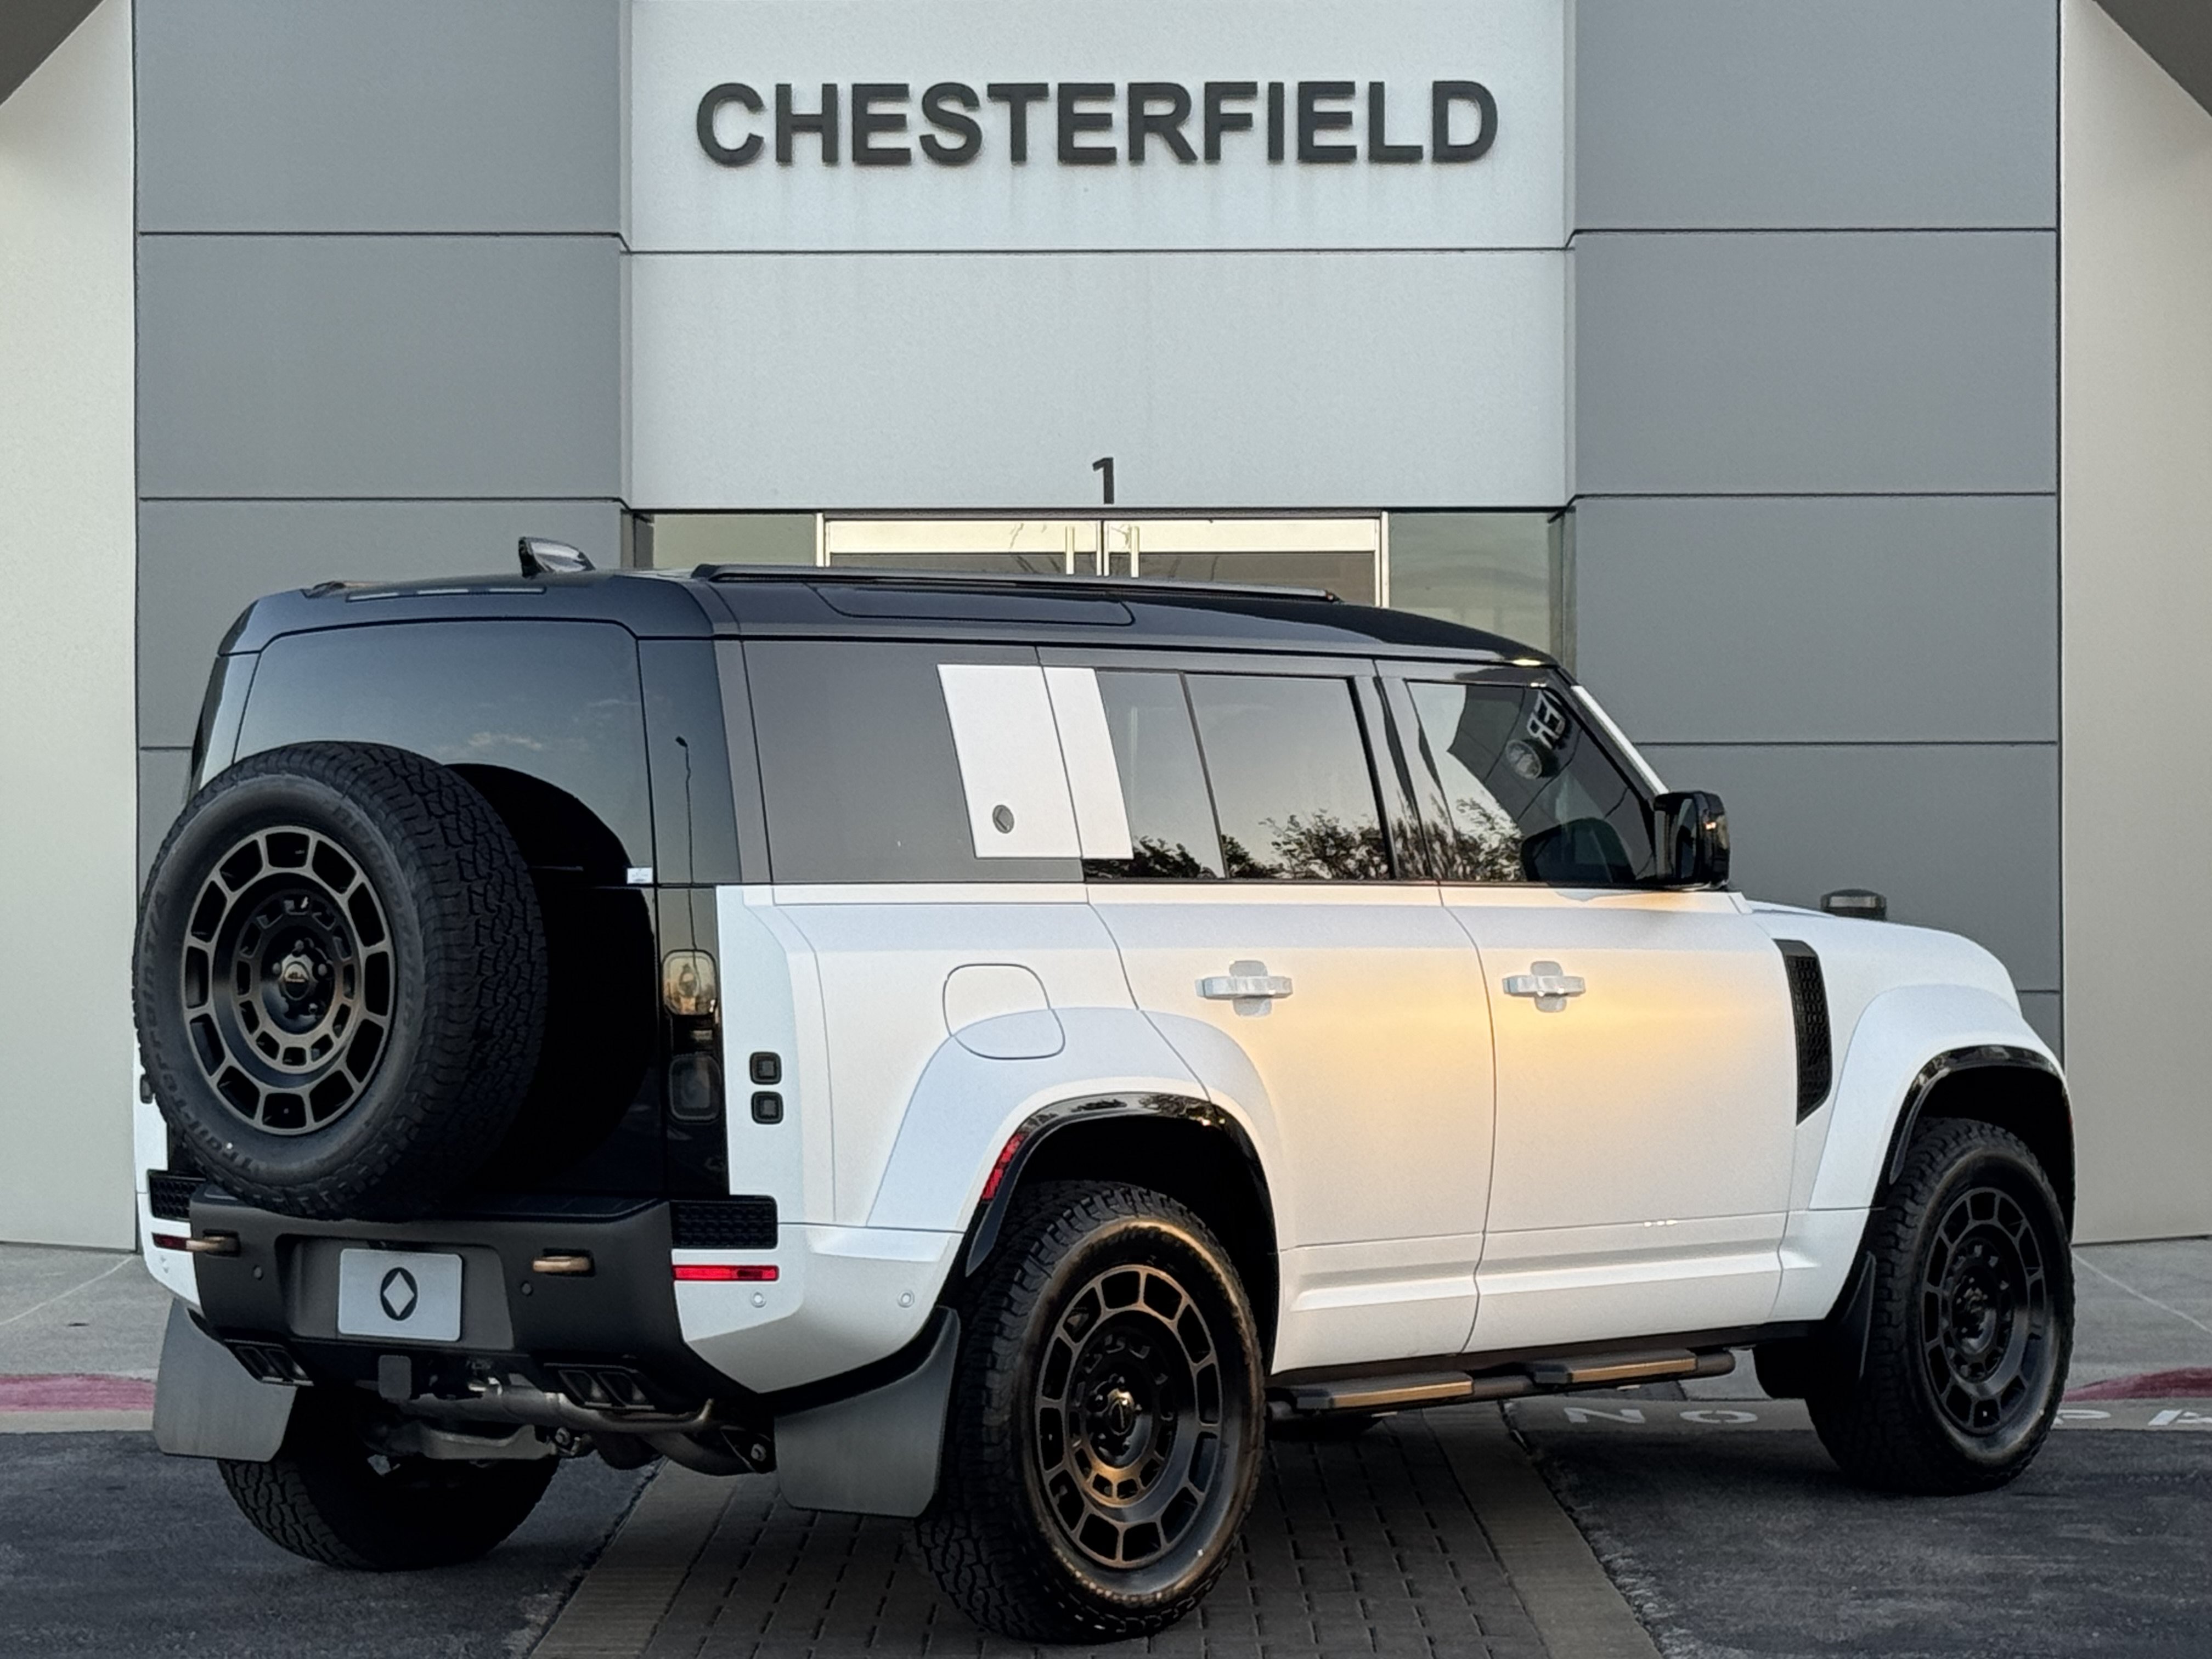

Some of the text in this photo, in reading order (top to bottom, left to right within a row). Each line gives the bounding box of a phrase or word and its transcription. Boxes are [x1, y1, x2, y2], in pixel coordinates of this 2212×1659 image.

[696, 81, 1499, 166] CHESTERFIELD
[1092, 457, 1115, 504] 1
[1564, 1407, 1758, 1424] NO
